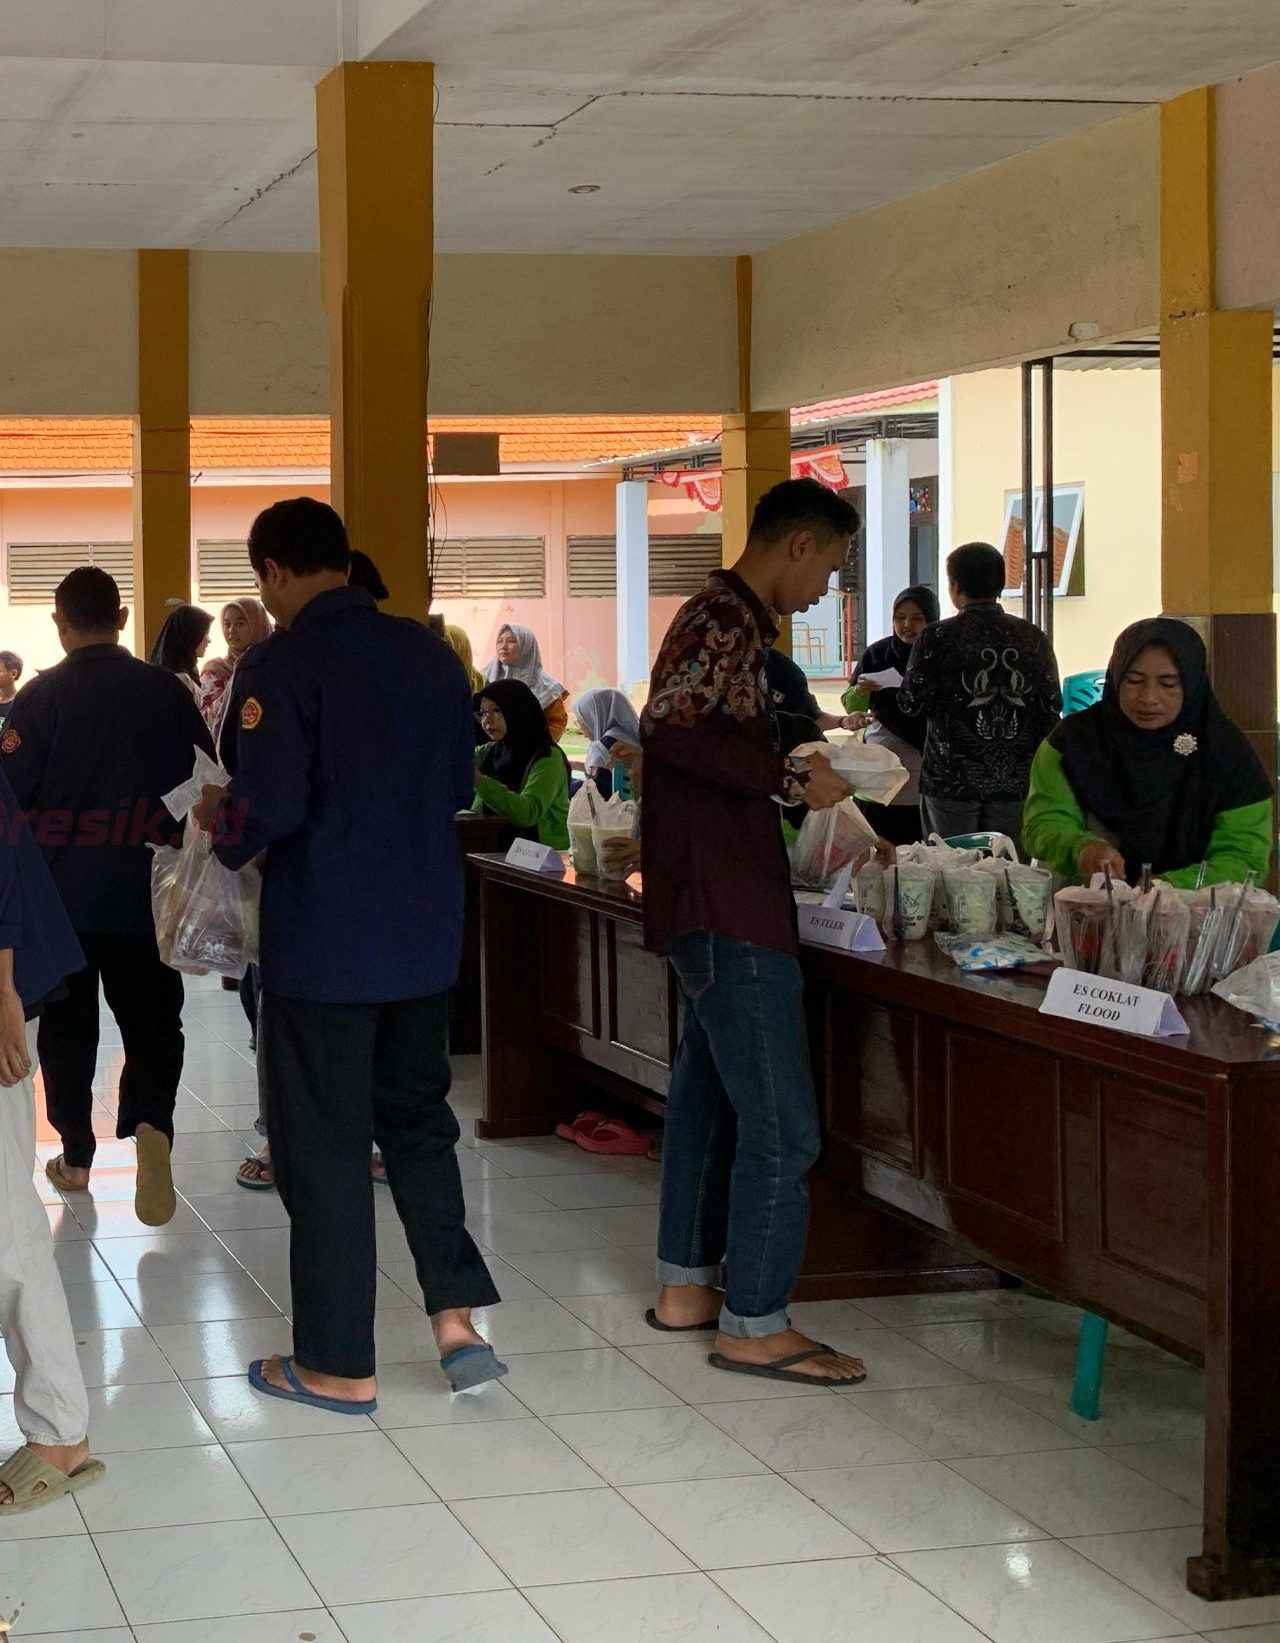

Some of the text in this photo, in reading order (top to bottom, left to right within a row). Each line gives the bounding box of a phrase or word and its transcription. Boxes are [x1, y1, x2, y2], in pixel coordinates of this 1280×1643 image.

[1072, 982, 1141, 1008] ES COKLAT
[1076, 1002, 1121, 1022] FLOOD
